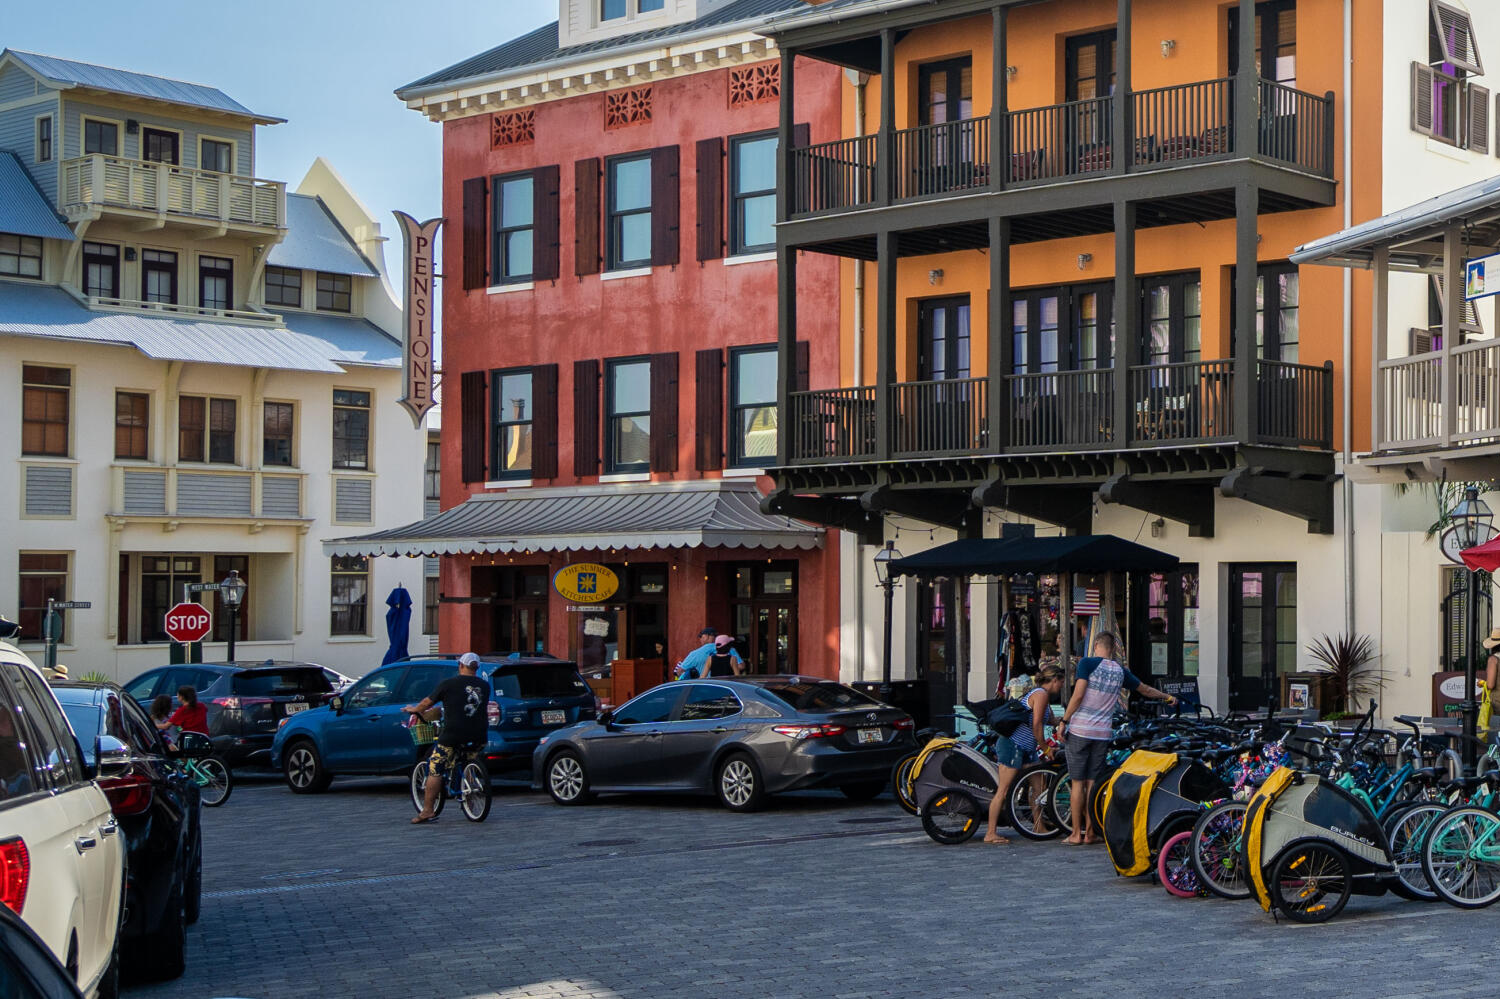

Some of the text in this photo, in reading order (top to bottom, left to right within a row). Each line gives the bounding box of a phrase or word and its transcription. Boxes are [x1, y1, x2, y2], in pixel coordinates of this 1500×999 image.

[412, 236, 429, 399] PENSIONE
[563, 565, 612, 578] THE SUMMER
[561, 587, 594, 601] KITCHEN
[168, 615, 208, 631] STOP
[1330, 825, 1376, 847] BURLEY
